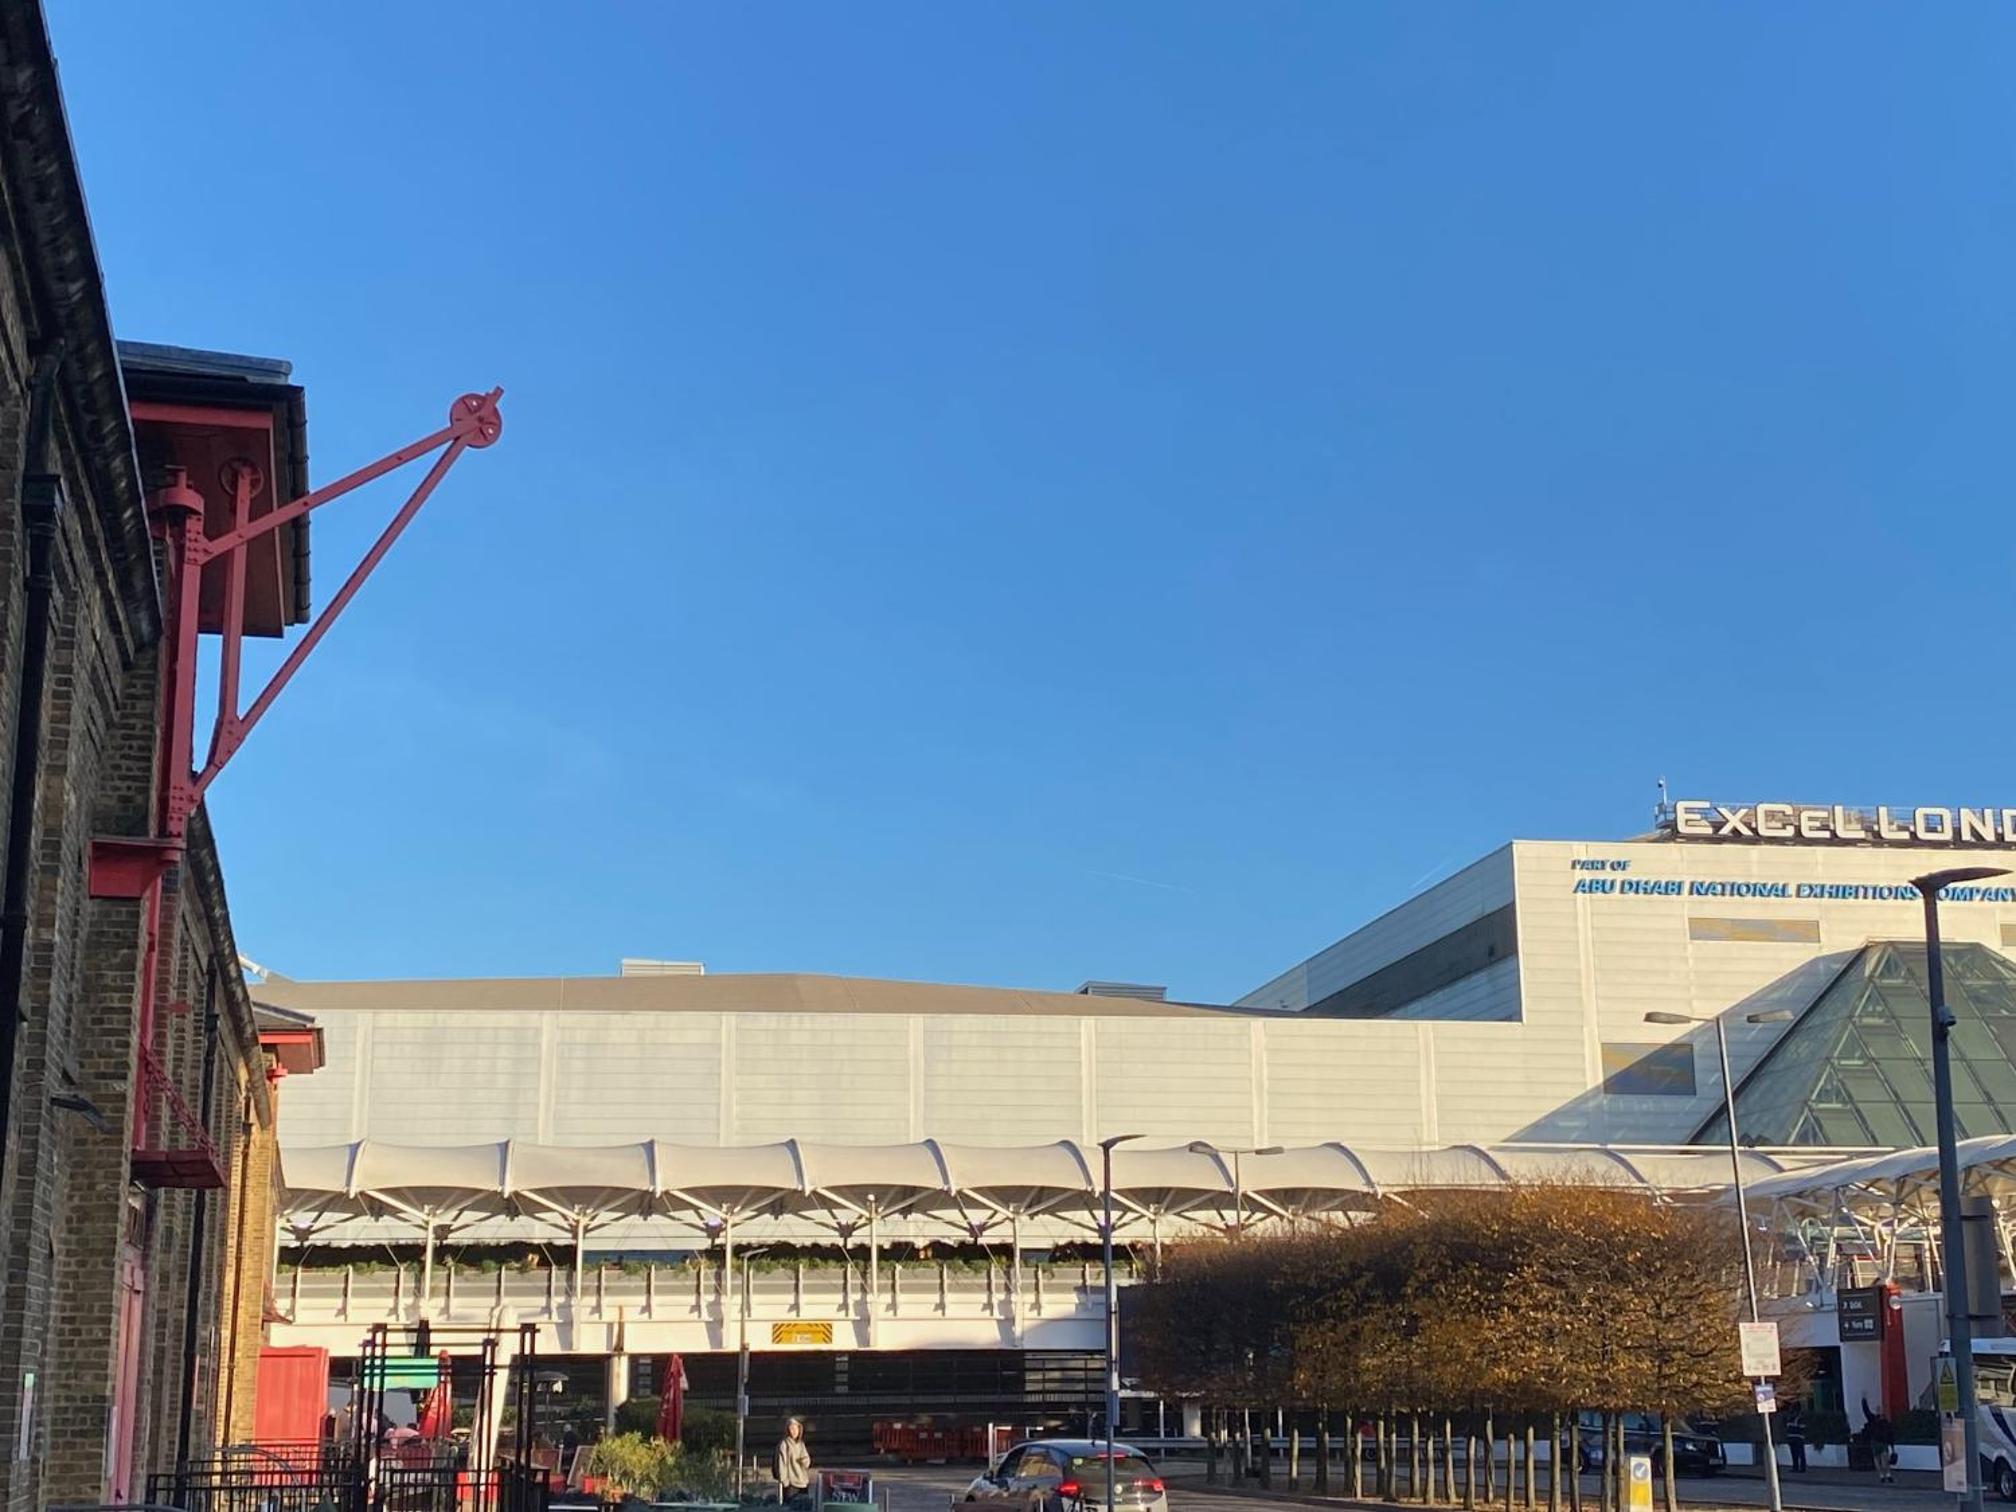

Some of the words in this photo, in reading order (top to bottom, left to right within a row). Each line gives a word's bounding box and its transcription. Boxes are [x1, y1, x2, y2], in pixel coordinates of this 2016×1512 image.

[1571, 859, 1609, 871] PART
[1610, 860, 1631, 872] OF
[1573, 878, 1617, 895] ABU
[1619, 879, 1685, 896] DHABI
[1688, 881, 1792, 898] NATIONAL
